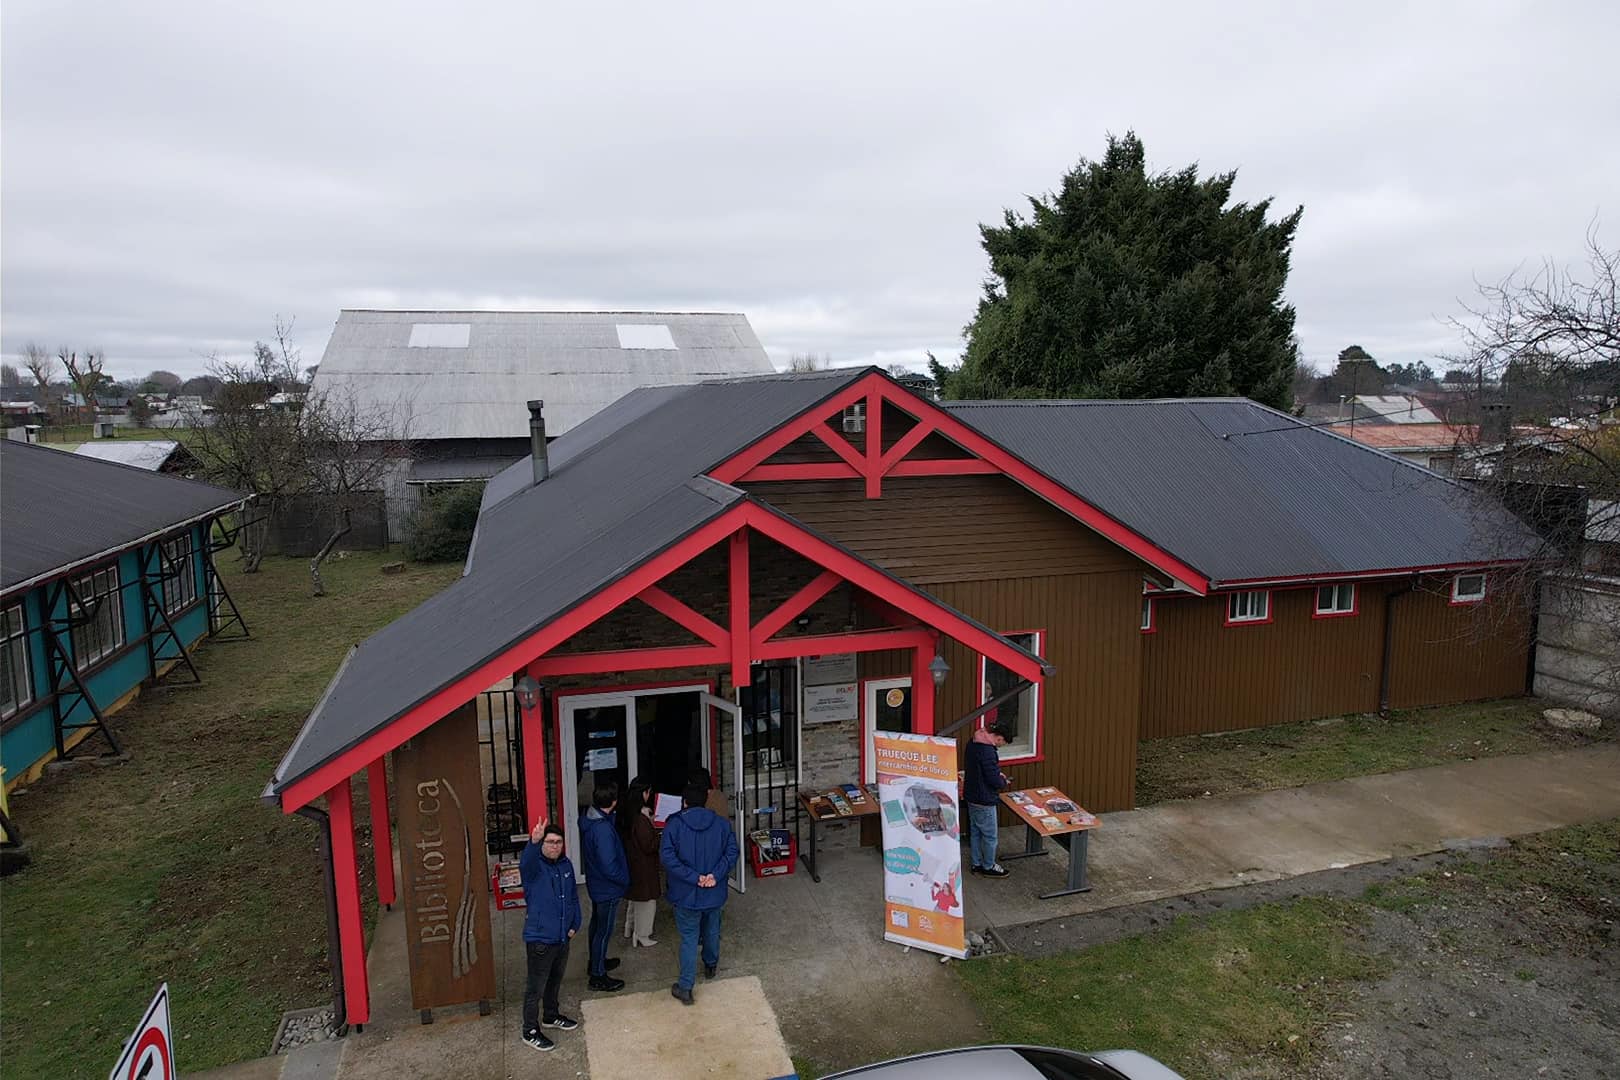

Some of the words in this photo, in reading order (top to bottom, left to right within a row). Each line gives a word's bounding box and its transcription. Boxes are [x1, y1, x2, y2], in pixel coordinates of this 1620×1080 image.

[877, 748, 919, 762] TRUEQUE
[921, 753, 938, 764] LEE
[929, 767, 950, 776] libros
[415, 778, 451, 944] Biblioteca
